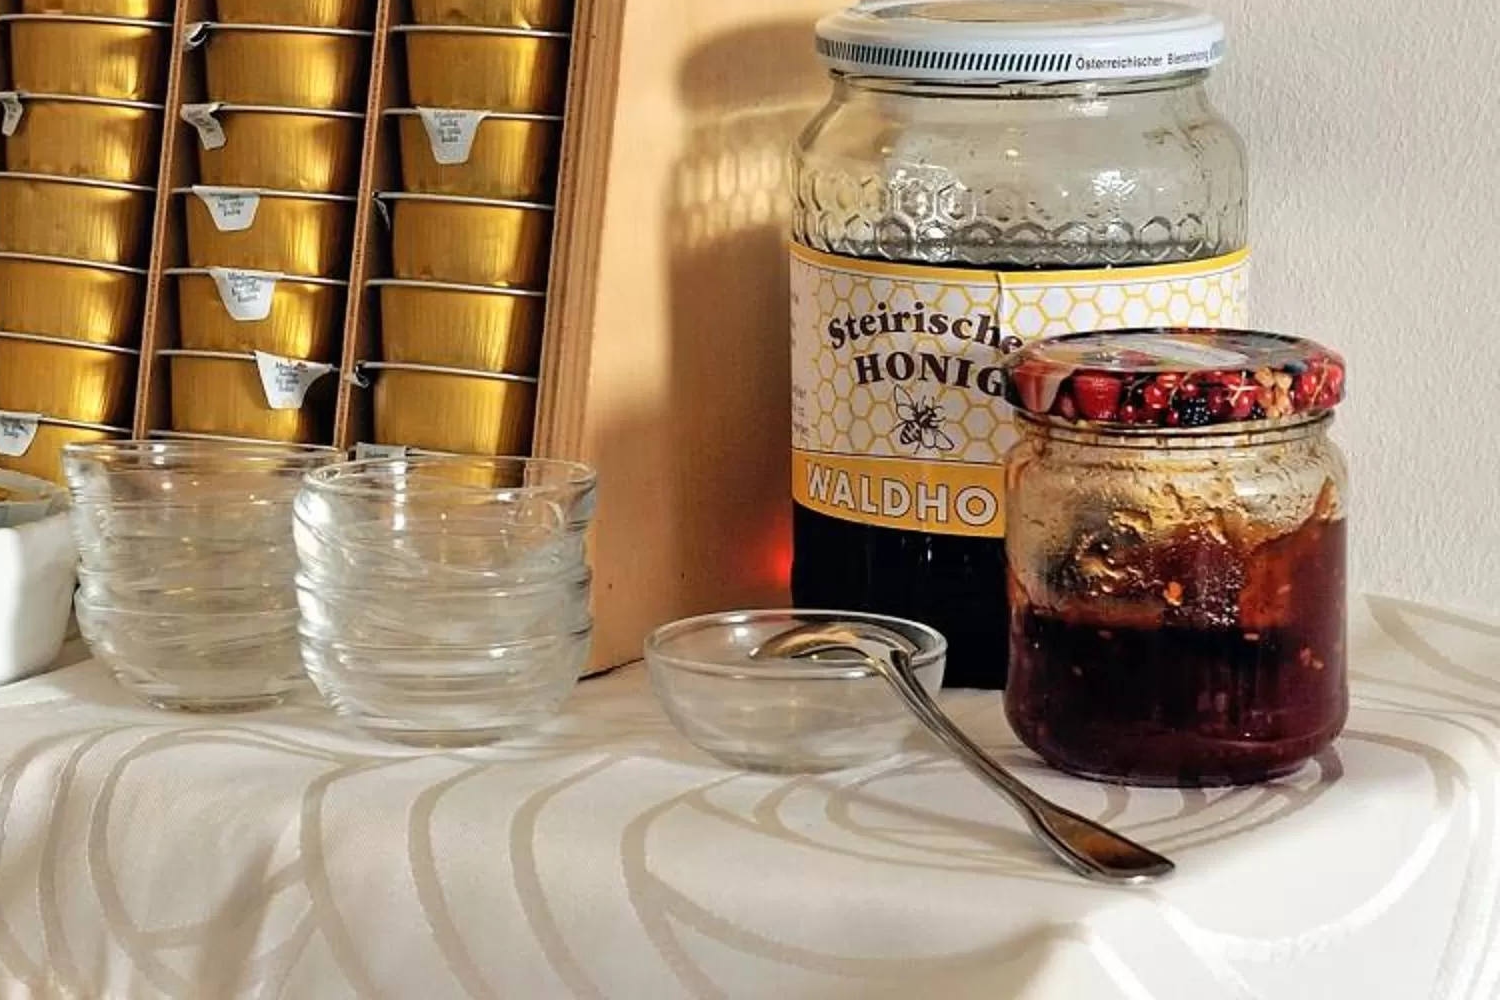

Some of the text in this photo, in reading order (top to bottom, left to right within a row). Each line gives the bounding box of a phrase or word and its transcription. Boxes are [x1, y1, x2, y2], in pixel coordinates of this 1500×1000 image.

[828, 301, 1024, 355] Steirische
[853, 351, 1003, 398] HONIG
[806, 460, 999, 527] WALDHO
